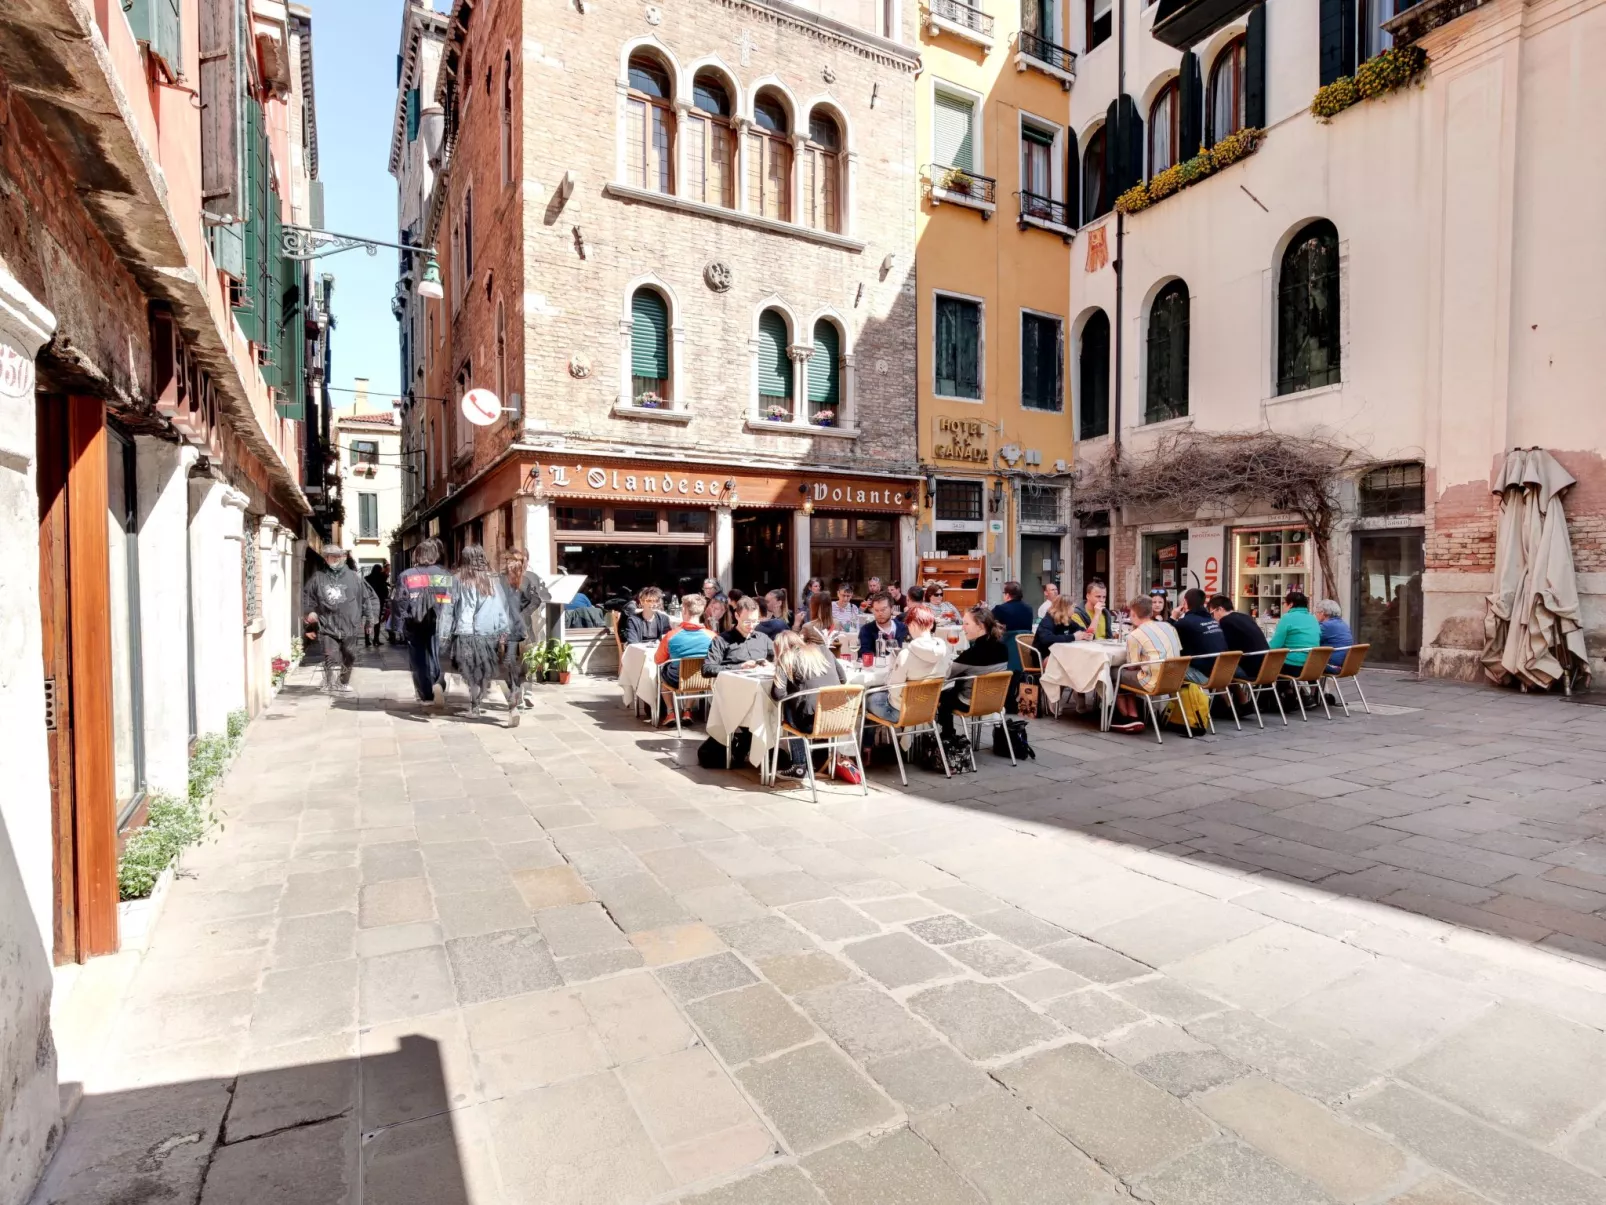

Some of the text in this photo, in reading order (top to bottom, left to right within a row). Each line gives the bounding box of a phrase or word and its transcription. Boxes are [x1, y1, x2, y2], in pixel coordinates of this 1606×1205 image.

[940, 419, 985, 436] HOTEL
[934, 444, 988, 462] CANADA
[549, 464, 903, 505] L'Olandese Volante
